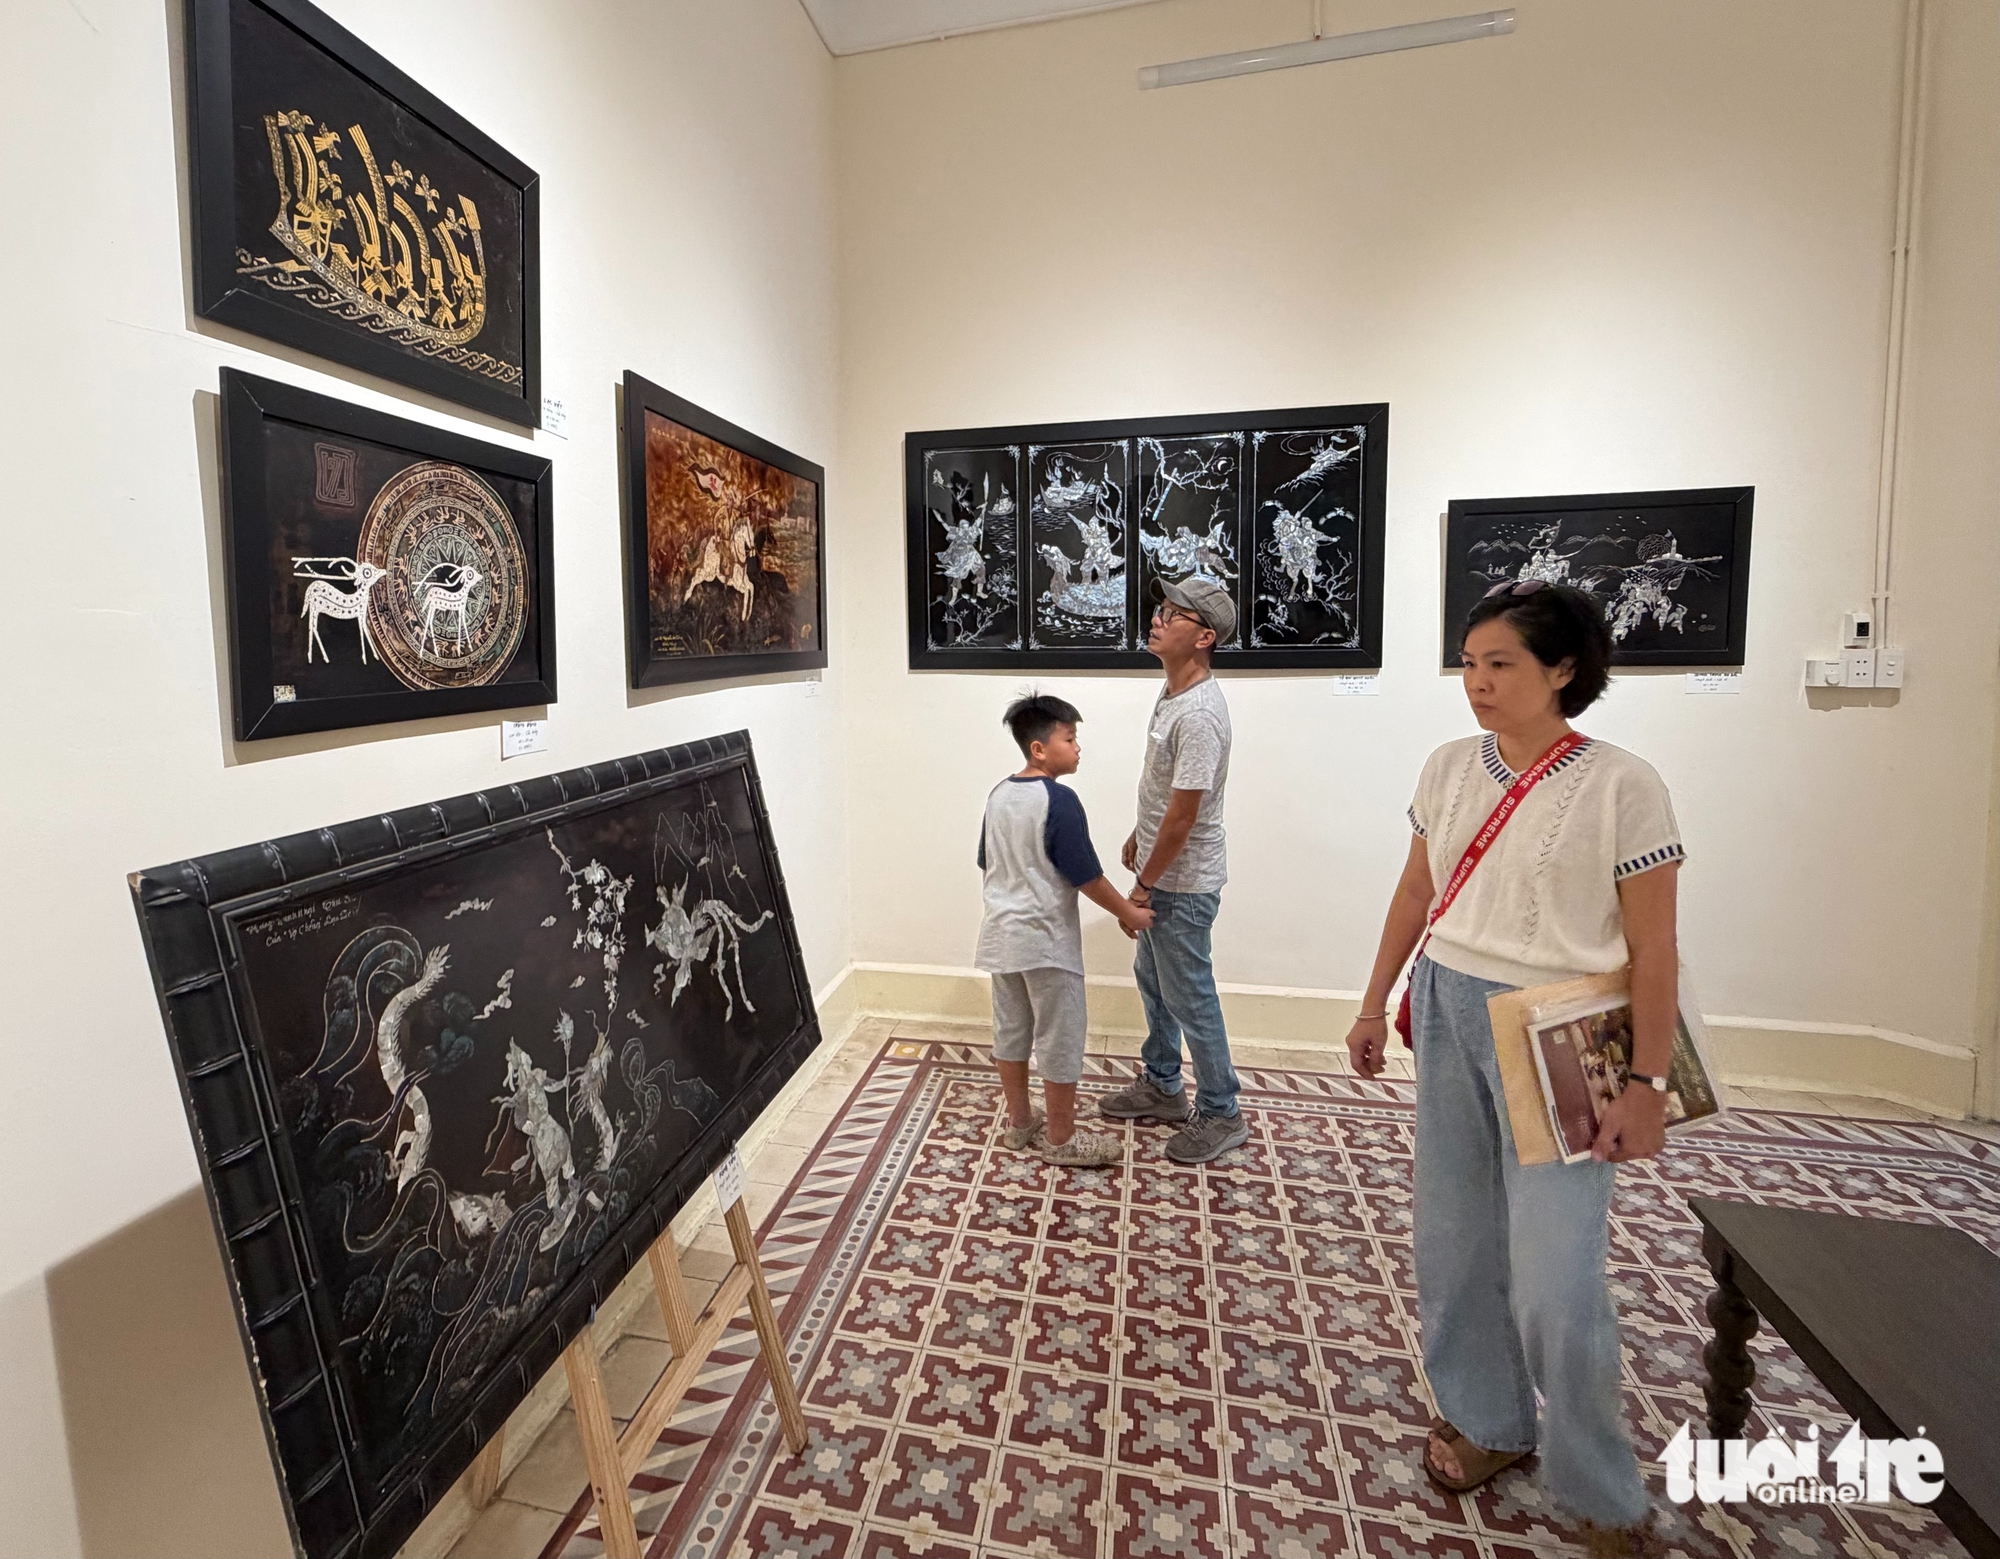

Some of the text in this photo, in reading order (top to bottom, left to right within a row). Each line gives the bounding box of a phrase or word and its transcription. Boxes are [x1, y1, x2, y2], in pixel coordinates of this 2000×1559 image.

[1443, 740, 1571, 904] SUPREME SUPREME SUPREME
